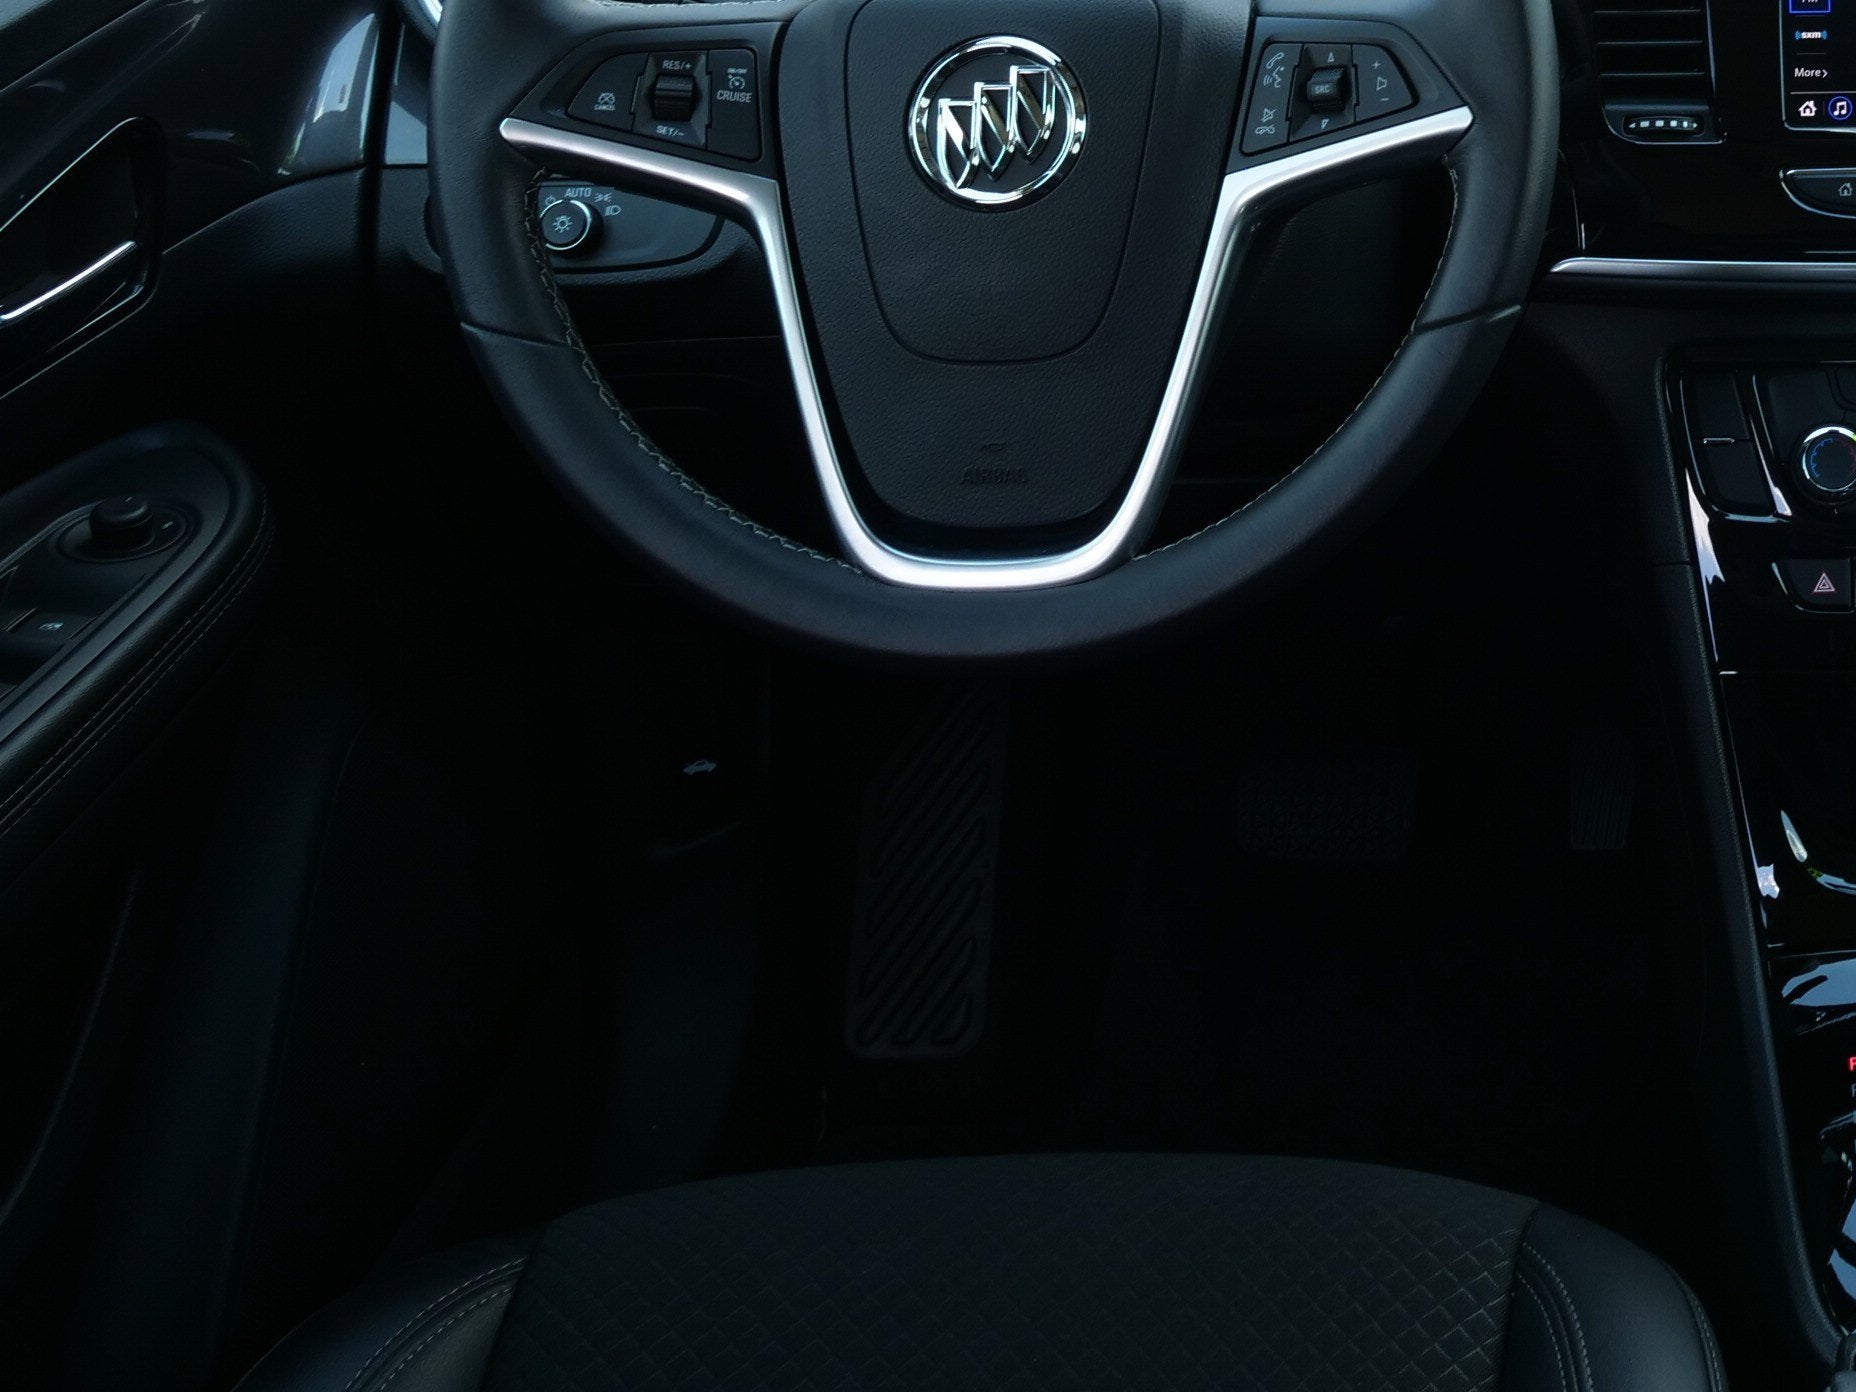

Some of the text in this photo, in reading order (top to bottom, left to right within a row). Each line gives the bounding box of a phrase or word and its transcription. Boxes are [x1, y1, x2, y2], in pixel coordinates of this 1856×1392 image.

[1794, 67, 1821, 78] More
[716, 90, 752, 104] CRUISE
[565, 186, 592, 199] AUTO
